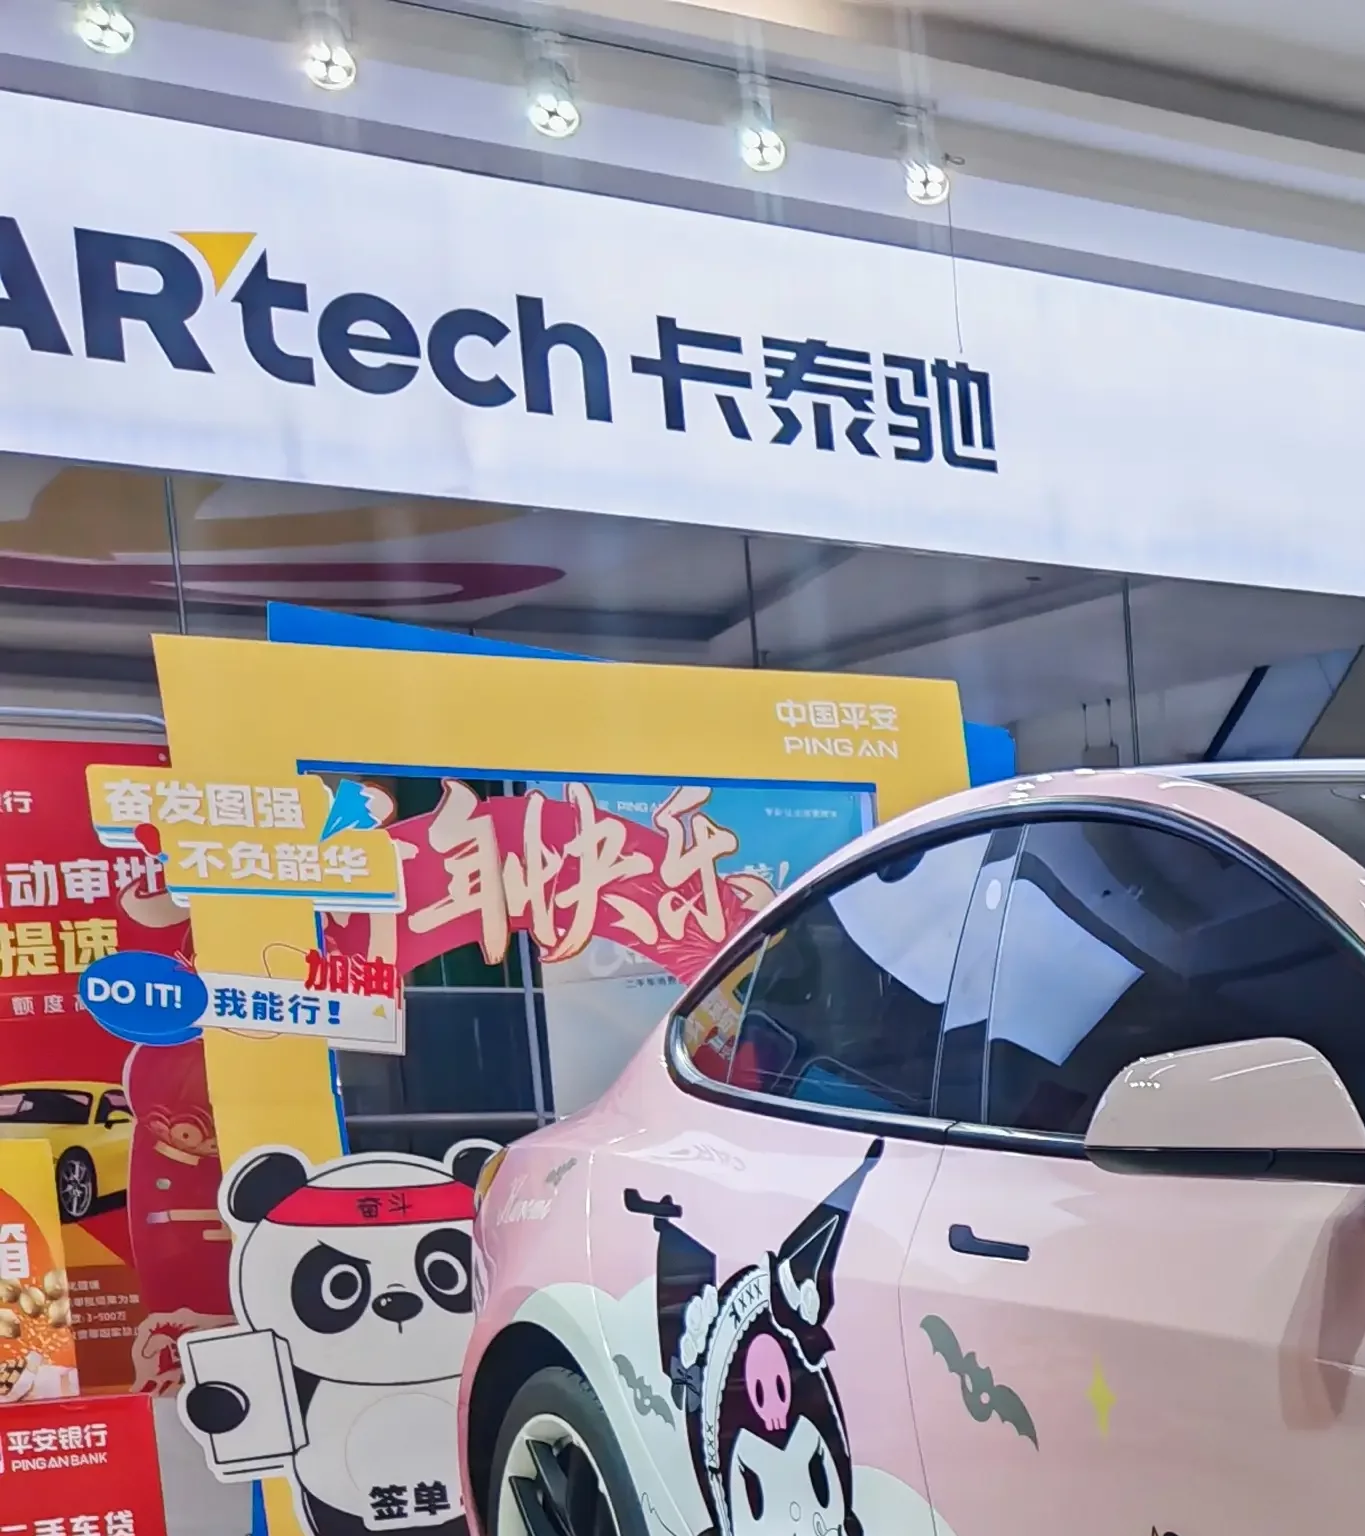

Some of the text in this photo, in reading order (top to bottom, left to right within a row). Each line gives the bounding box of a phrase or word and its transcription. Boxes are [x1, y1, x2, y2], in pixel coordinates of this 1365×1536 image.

[631, 315, 1001, 473] 卡泰驰
[776, 699, 899, 731] 中国平安
[104, 779, 305, 829] 奋发图强
[0, 857, 163, 907] 动审批
[178, 841, 369, 882] 不负韶华
[87, 977, 182, 1009] DO IT!
[304, 949, 396, 999] 加油
[6, 1423, 108, 1455] 平安银行
[368, 1480, 451, 1521] 签单
